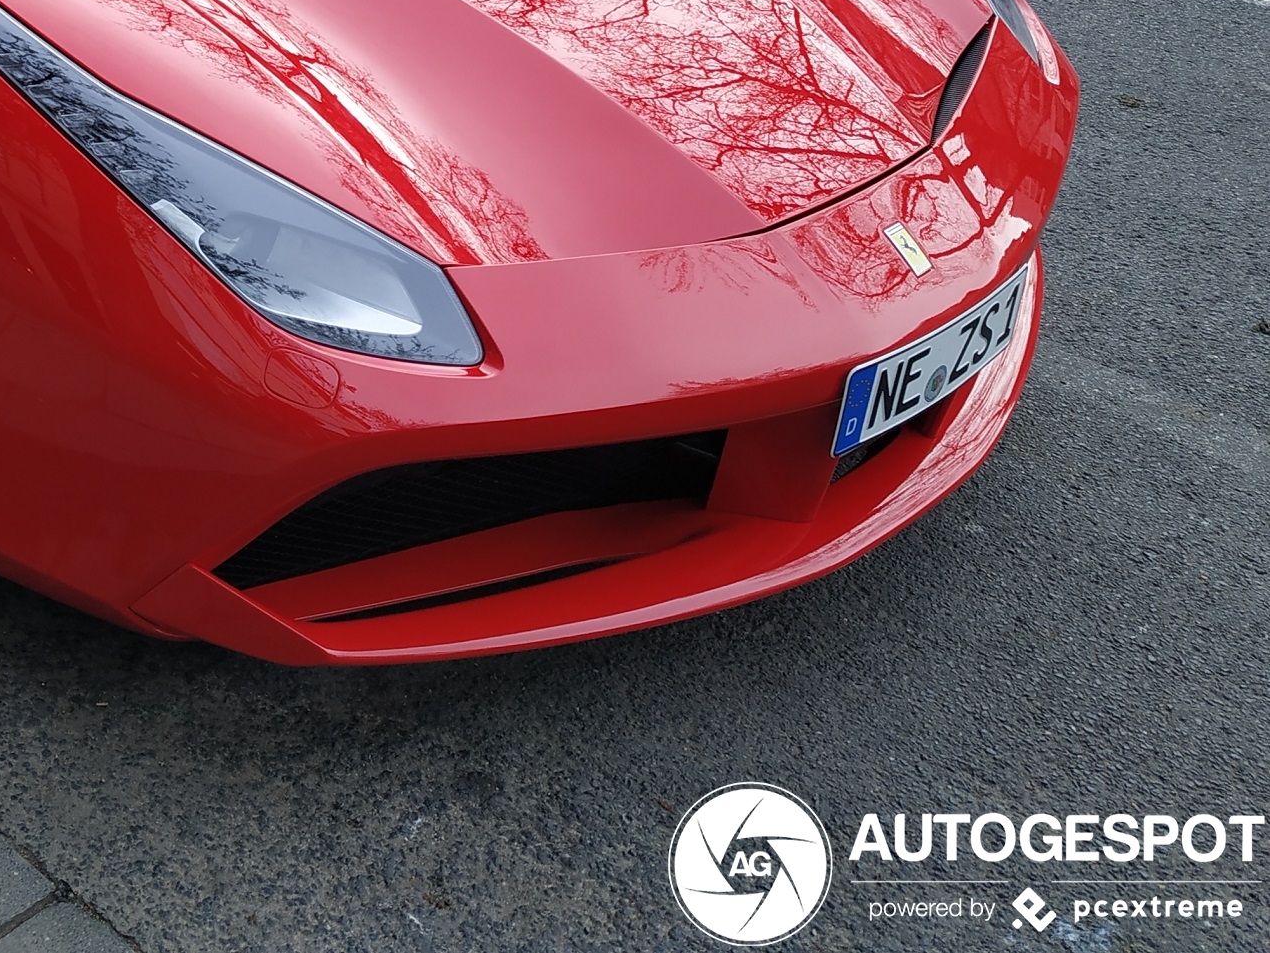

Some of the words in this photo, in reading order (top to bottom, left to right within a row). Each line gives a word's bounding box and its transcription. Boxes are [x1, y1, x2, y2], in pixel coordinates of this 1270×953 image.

[867, 347, 931, 430] NE
[947, 302, 1000, 385] ZS
[995, 282, 1021, 347] 1
